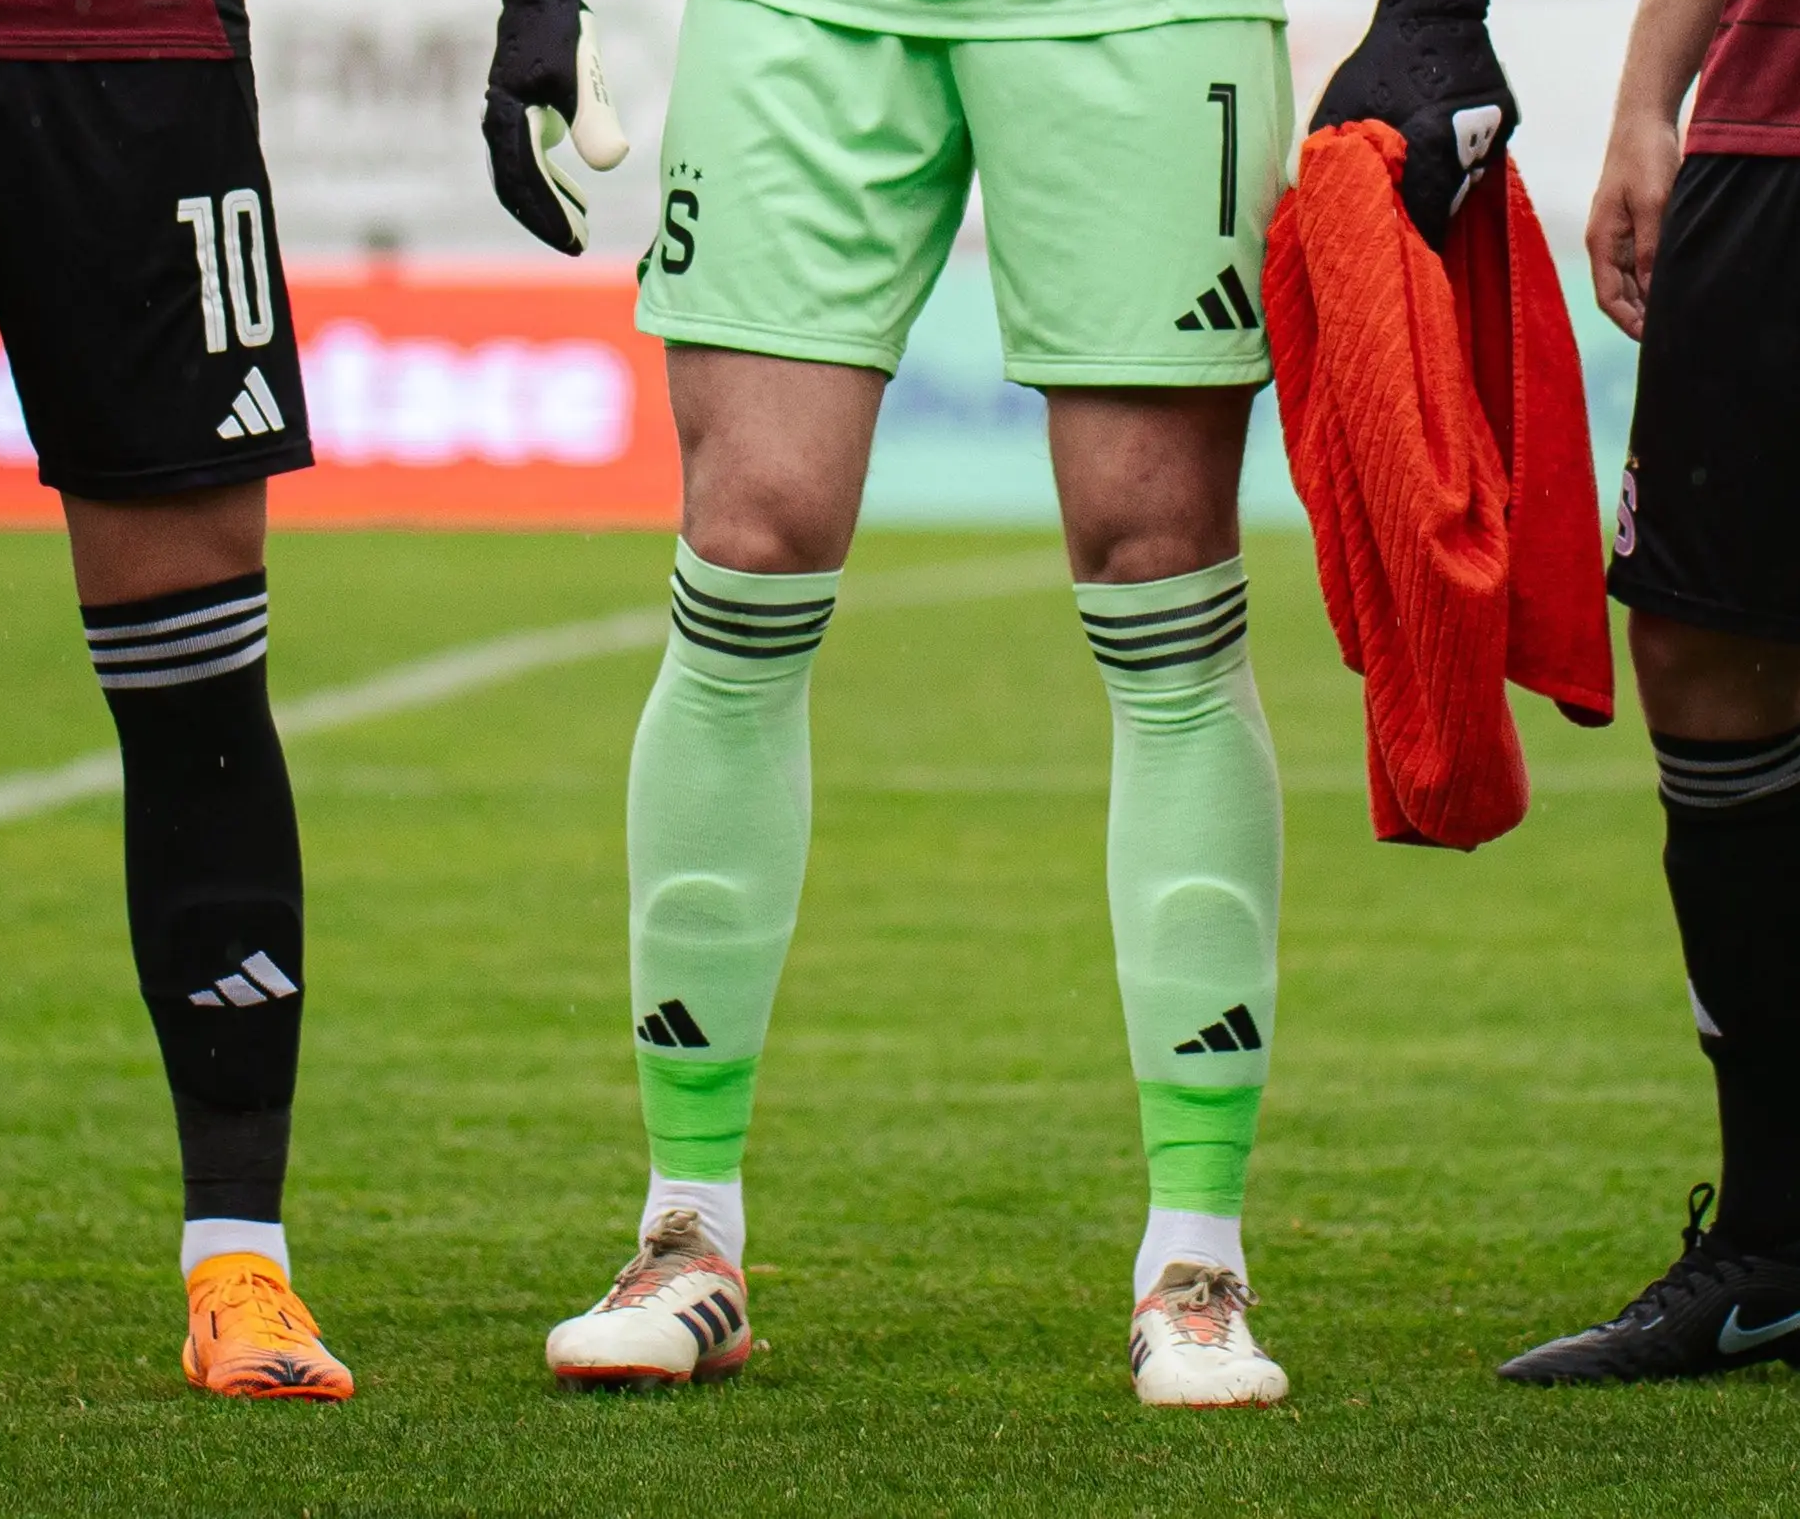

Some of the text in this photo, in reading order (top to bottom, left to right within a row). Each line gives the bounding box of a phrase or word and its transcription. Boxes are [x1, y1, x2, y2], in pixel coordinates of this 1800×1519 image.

[661, 188, 700, 276] S
[1208, 82, 1237, 238] 1
[176, 188, 274, 356] 10
